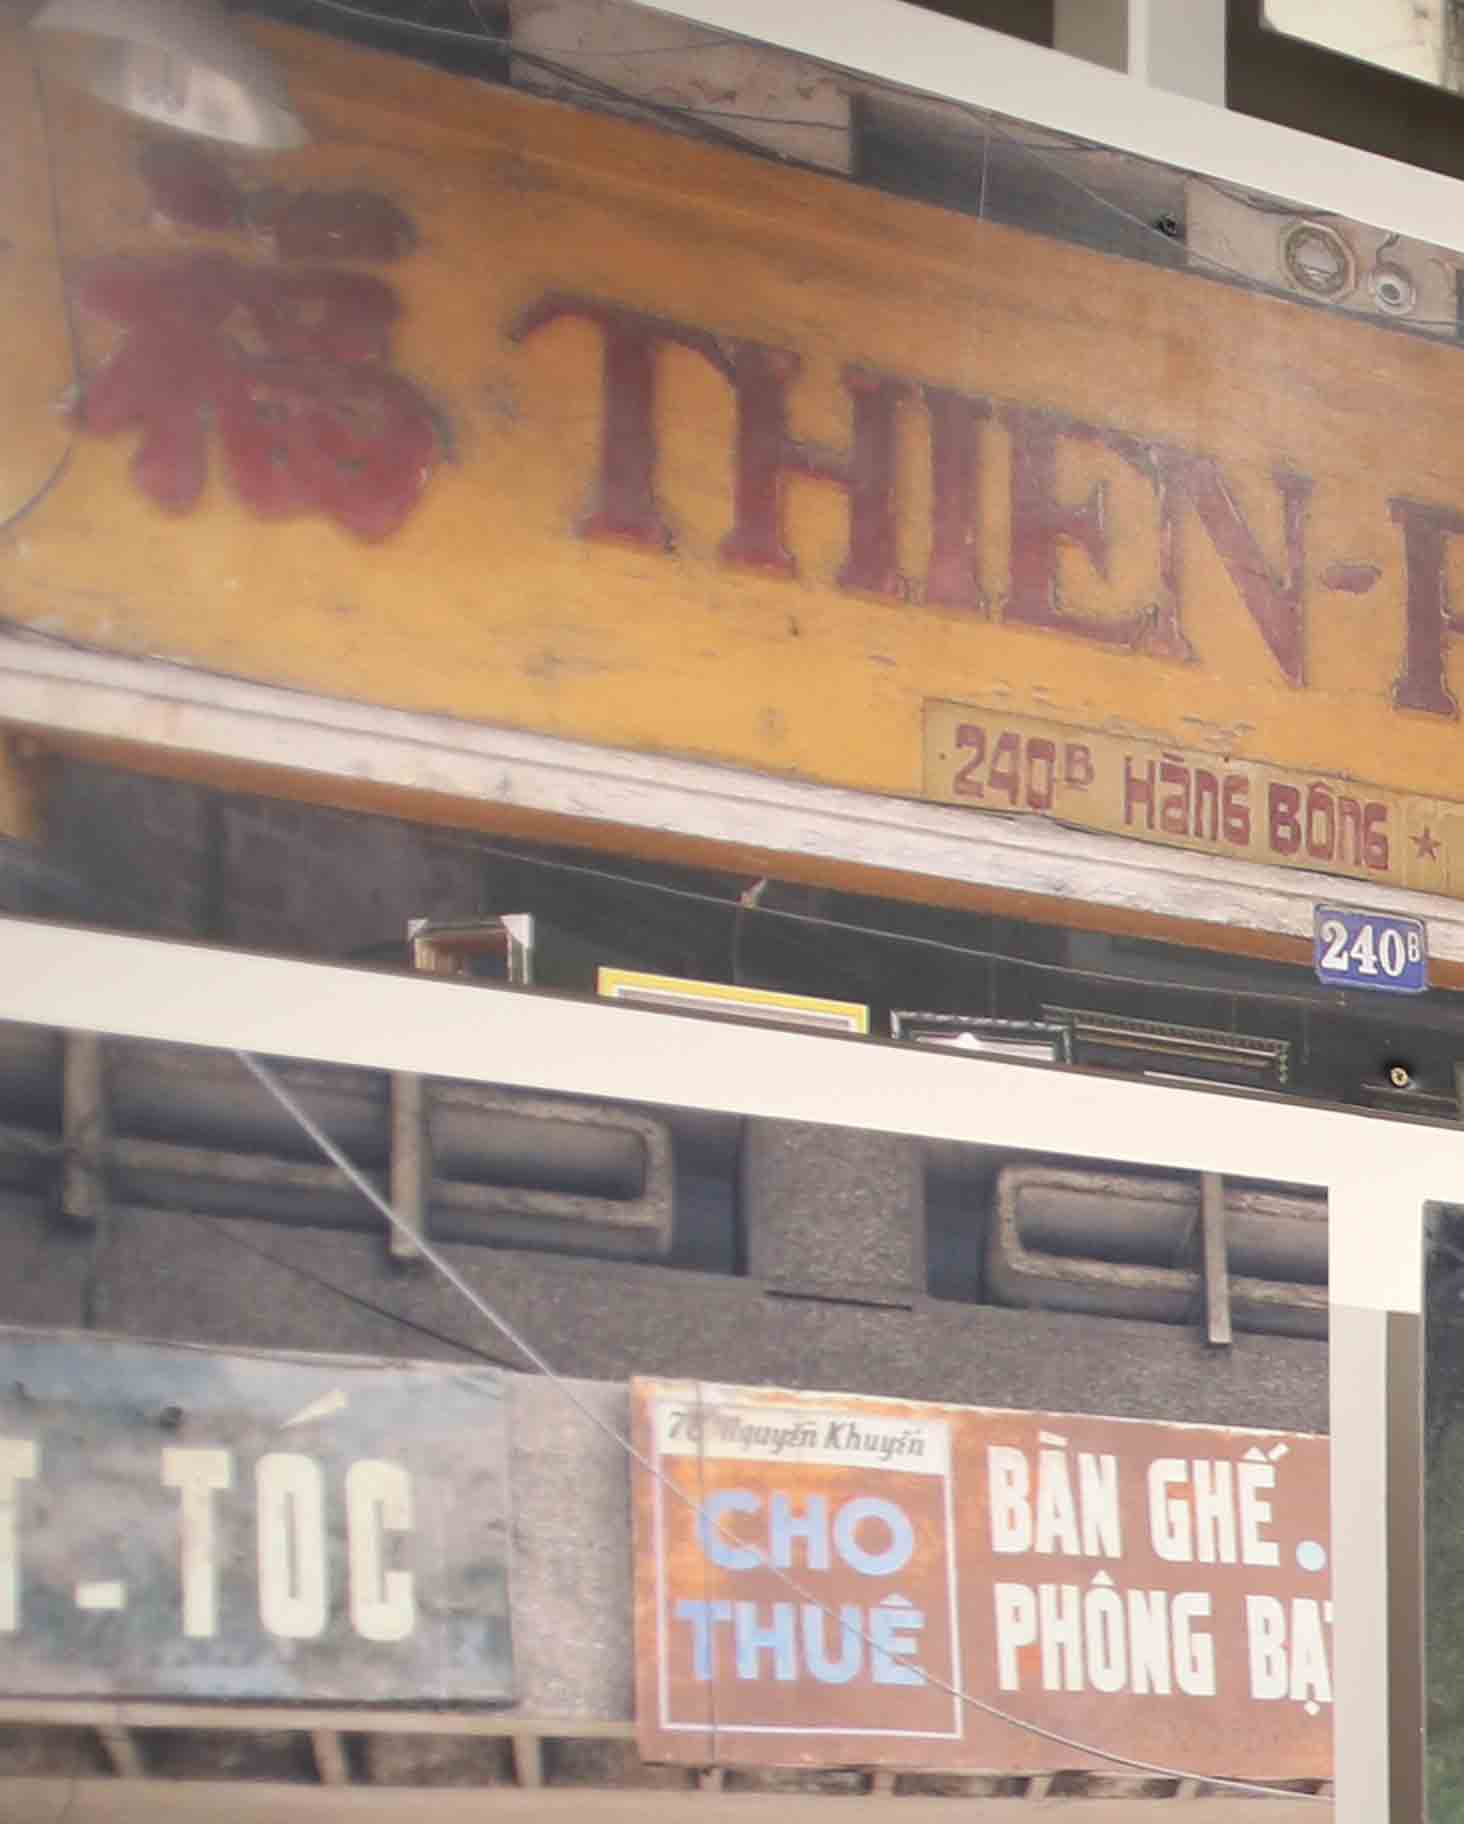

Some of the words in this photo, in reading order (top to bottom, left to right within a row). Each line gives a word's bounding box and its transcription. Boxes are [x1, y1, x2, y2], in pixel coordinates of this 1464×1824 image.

[161, 1388, 416, 1642] TÓC
[696, 1487, 915, 1577] CHO
[986, 1430, 1123, 1561] BÀN
[676, 1591, 928, 1689] THUÊ
[992, 1568, 1217, 1699] PHÔNG
